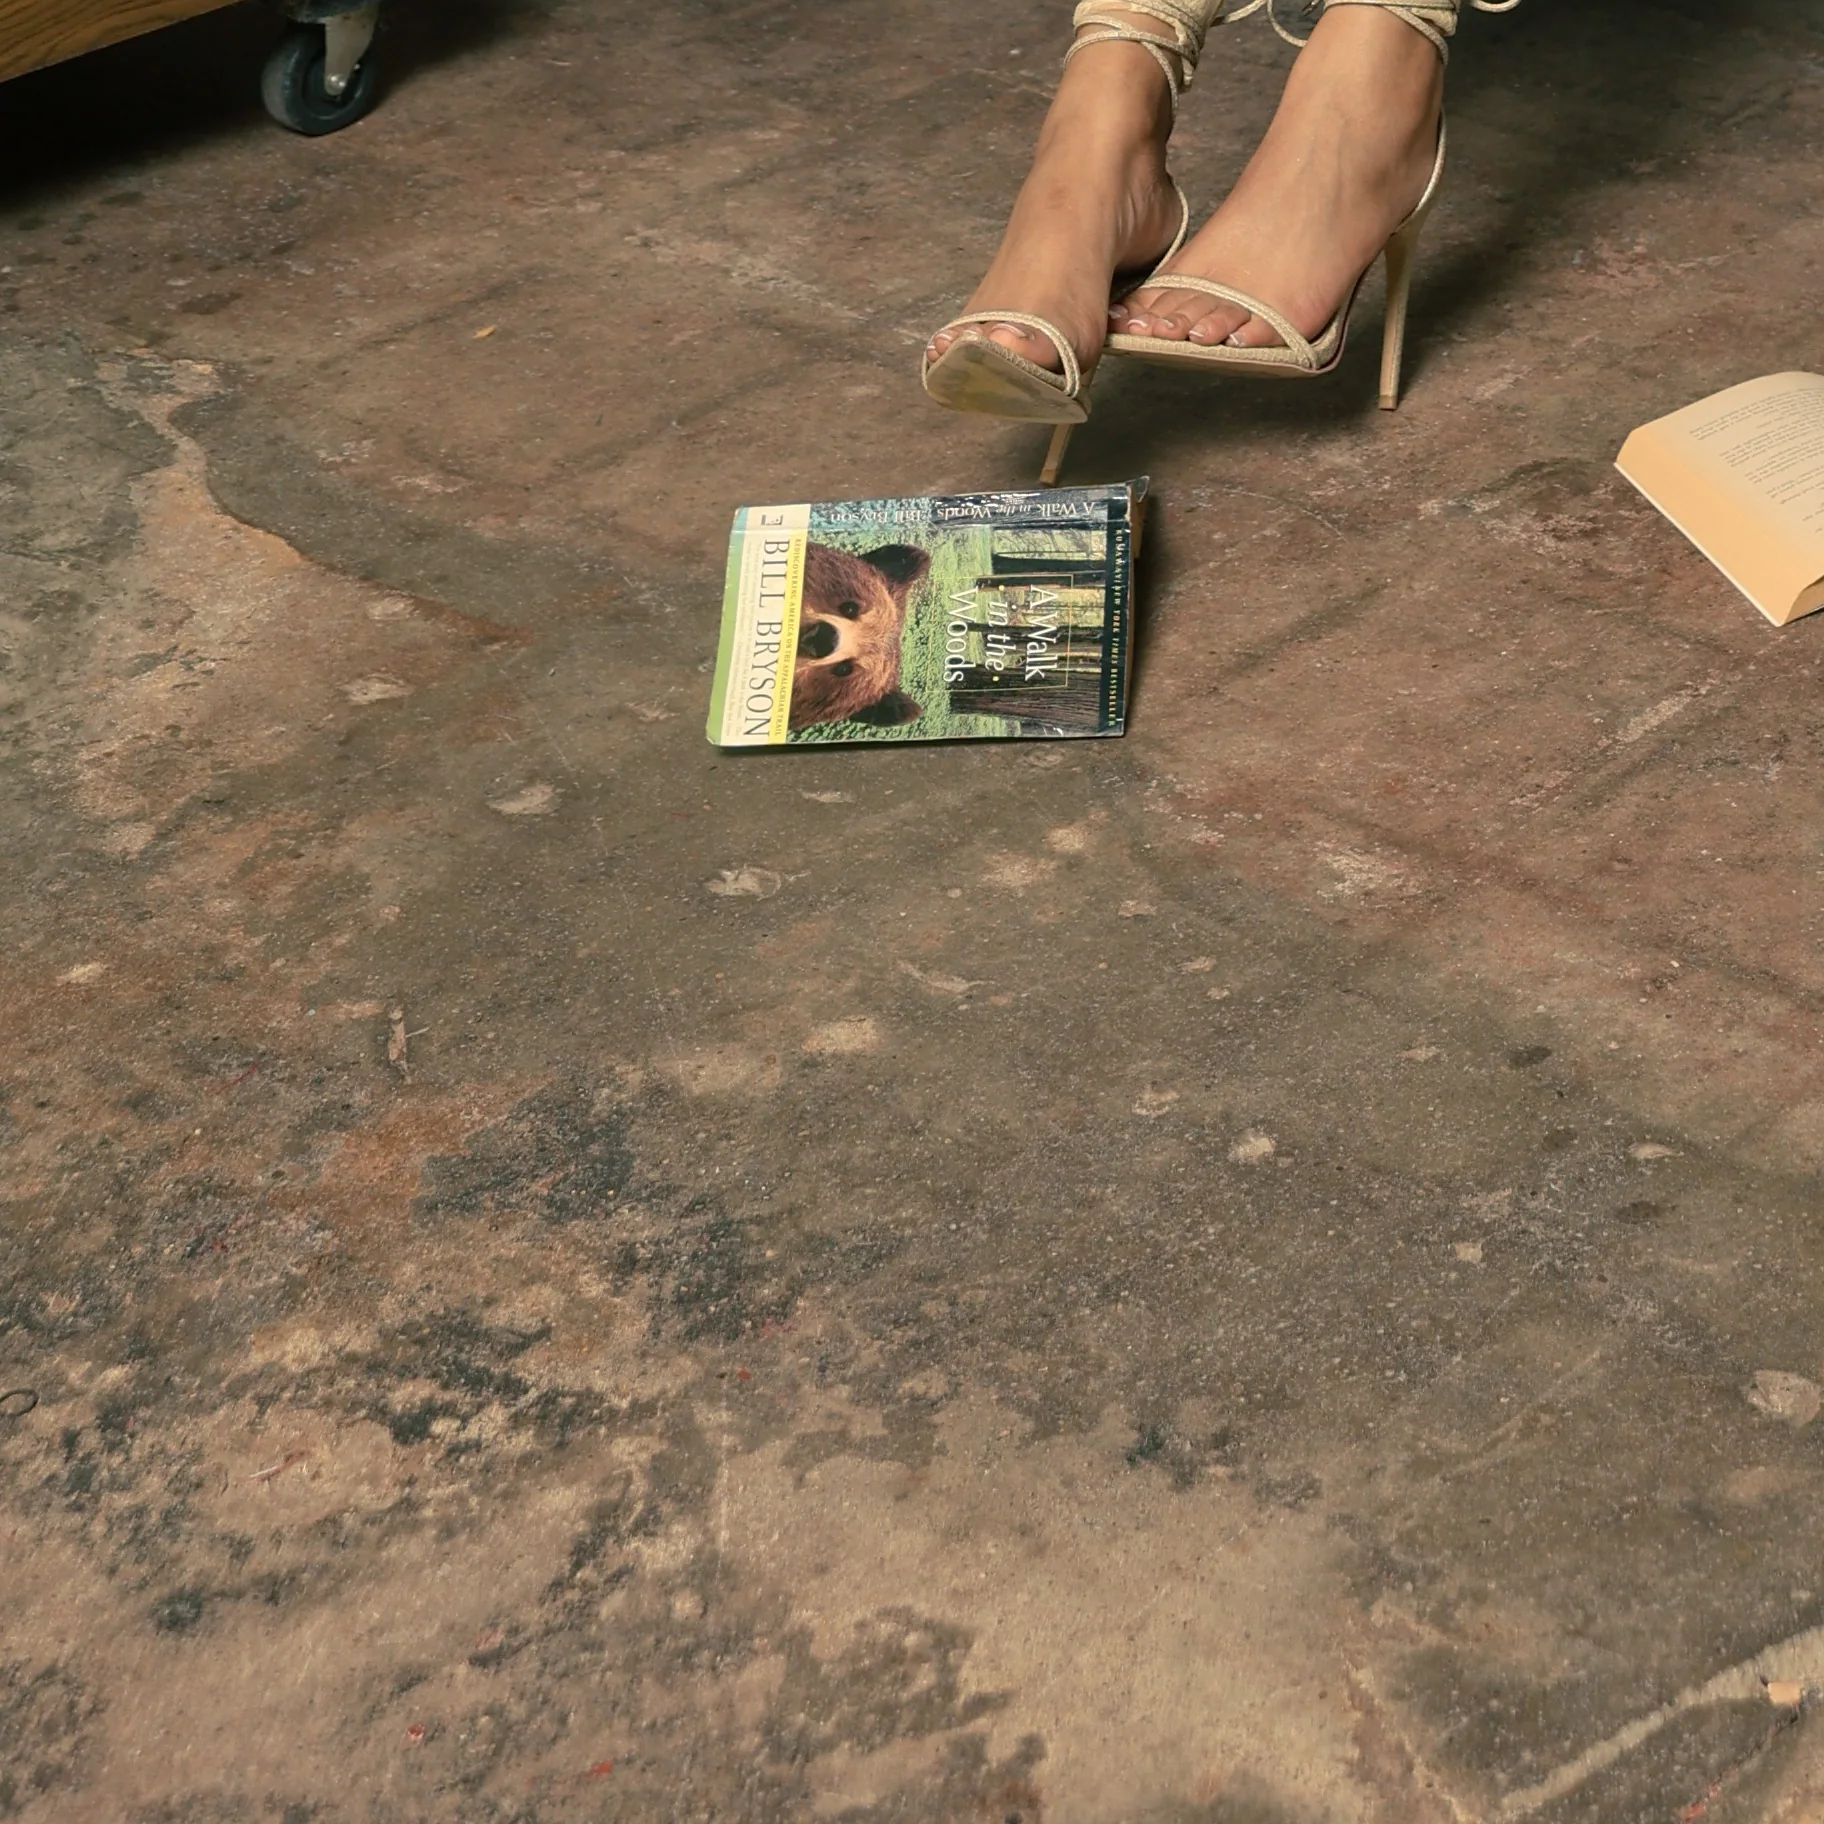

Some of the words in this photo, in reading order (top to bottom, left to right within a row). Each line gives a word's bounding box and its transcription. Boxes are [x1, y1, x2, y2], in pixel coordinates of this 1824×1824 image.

[830, 508, 888, 524] Bryson
[895, 510, 922, 525] Bill
[936, 506, 991, 520] Woods
[1037, 502, 1077, 515] Walk
[1083, 501, 1095, 513] A
[758, 539, 790, 608] BILL
[789, 539, 801, 599] REDISCOVERING
[1030, 585, 1058, 609] A
[787, 602, 796, 637] AMERICA
[988, 601, 1017, 626] in
[943, 586, 978, 682] Woods
[1025, 611, 1058, 681] Walk
[784, 650, 792, 663] THE
[985, 634, 1016, 671] the
[1111, 637, 1120, 665] TIMES
[743, 620, 784, 737] BRYSON
[777, 664, 790, 712] APPALACHIAN
[1108, 668, 1118, 727] BESTSELLER
[775, 714, 784, 736] TRAIL
